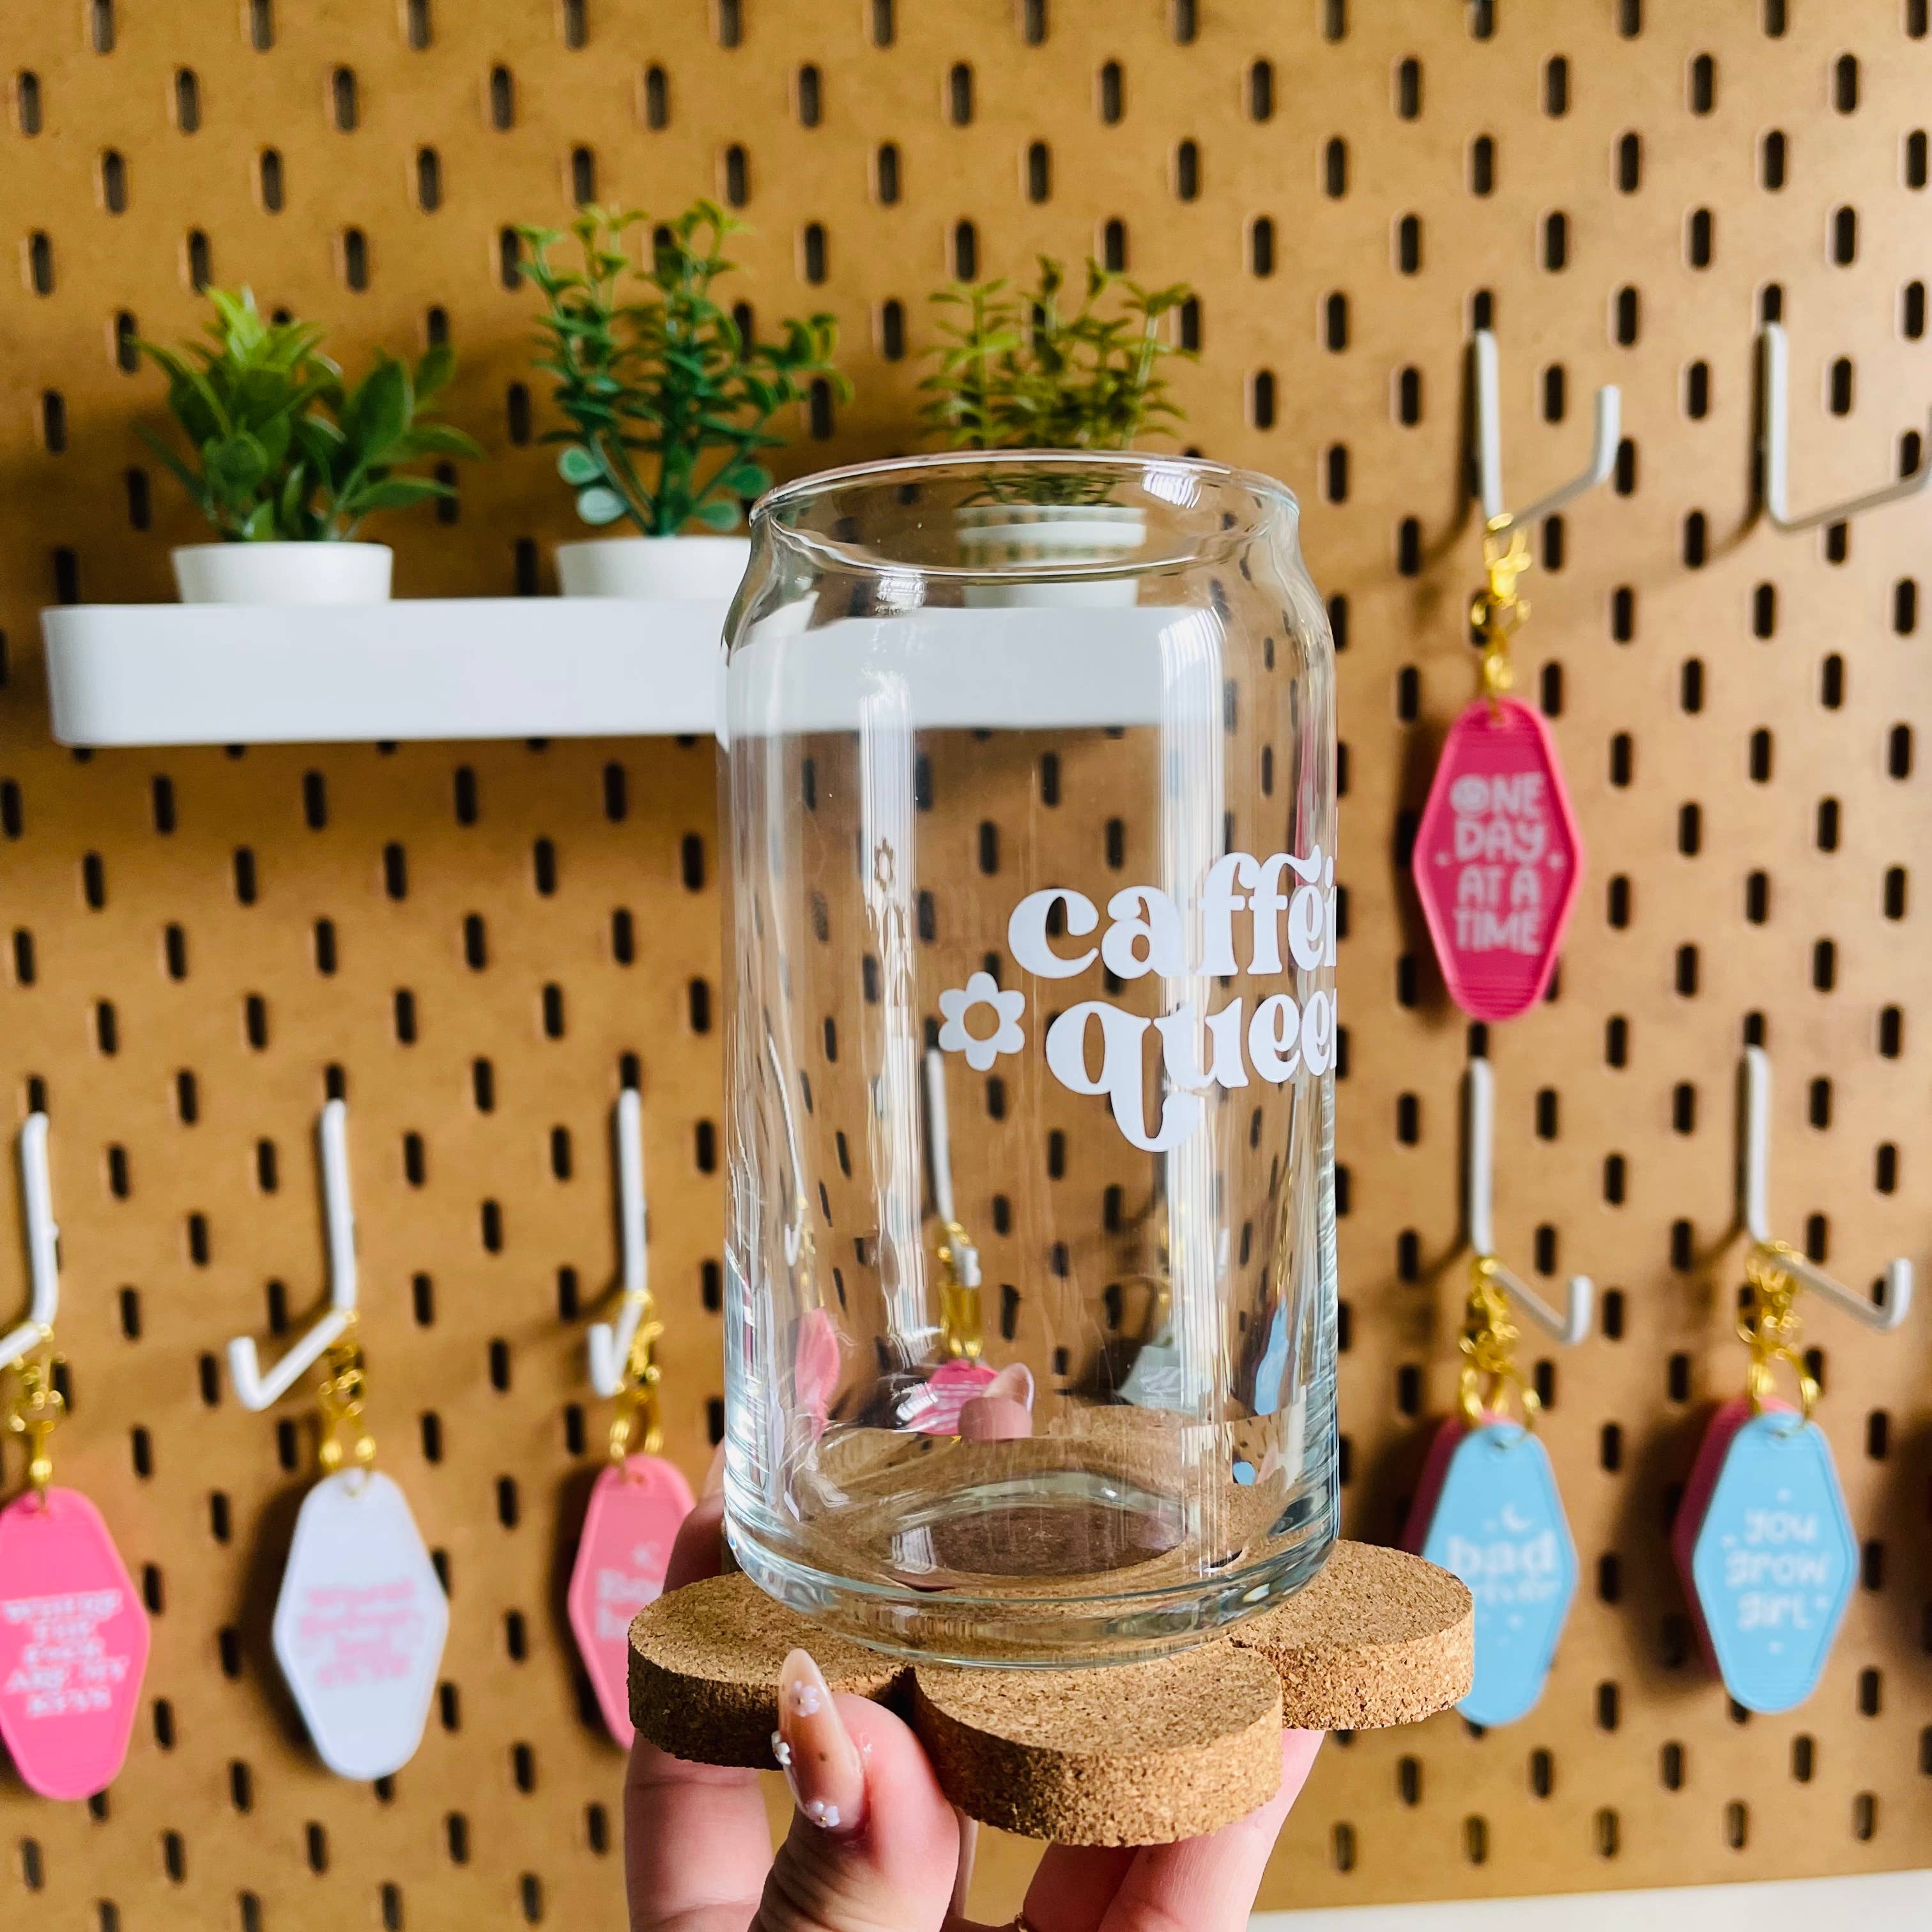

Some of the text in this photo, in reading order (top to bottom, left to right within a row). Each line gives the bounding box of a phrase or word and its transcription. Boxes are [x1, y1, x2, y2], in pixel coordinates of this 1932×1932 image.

[1450, 772, 1545, 818] ONE
[1453, 818, 1546, 863] DAY
[1457, 864, 1541, 905] AT A
[1008, 845, 1336, 979] caffei
[1453, 908, 1542, 956] TIME
[1046, 988, 1337, 1152] quee
[1446, 1529, 1556, 1576] bad
